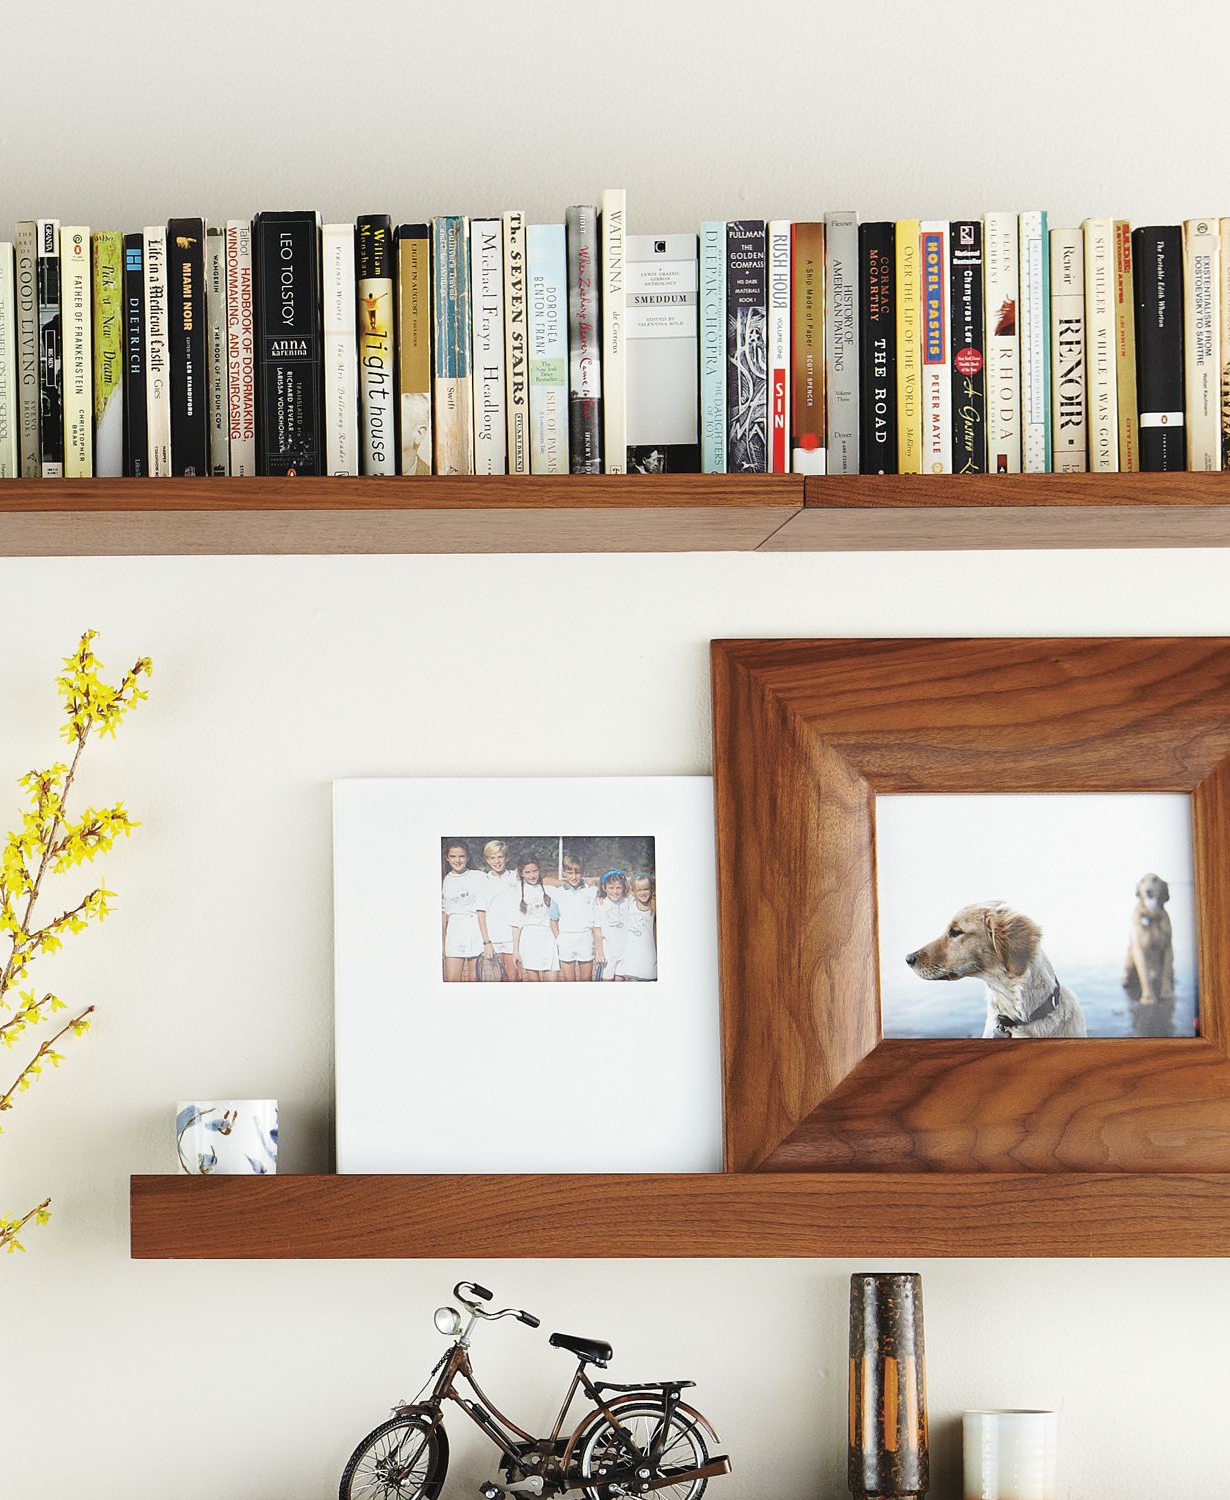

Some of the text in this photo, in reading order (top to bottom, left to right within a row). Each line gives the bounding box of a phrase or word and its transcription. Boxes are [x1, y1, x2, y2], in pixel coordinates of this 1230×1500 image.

[360, 225, 371, 276] Monahan
[373, 229, 385, 275] William
[729, 231, 764, 239] PULLMAN
[730, 252, 764, 260] GOLDEN
[730, 261, 764, 269] COMPASS
[182, 263, 192, 331] MIAMI NOIR
[279, 233, 294, 326] LEO TOLSTOY
[410, 243, 419, 315] LIGHT IN AUGUST
[477, 232, 497, 351] Michael Frayn
[634, 295, 687, 304] SMEDDUM
[705, 231, 719, 376] DEEPAK CHOPRA
[833, 259, 844, 372] AMERICAN PAINTING
[844, 285, 853, 345] HISTORY OF
[870, 250, 880, 321] McCARTHY
[880, 257, 889, 313] CORMAC
[928, 242, 940, 355] HOTEL PASTIS
[20, 257, 35, 385] GOOD LIVING
[74, 276, 83, 395] FATHER OF FRANKENSTEIN
[129, 298, 140, 373] DIETRICH
[446, 387, 455, 410] Swift
[479, 365, 499, 440] Headlong
[874, 339, 887, 443] THE ROAD
[1000, 348, 1013, 441] RHODA
[1058, 319, 1083, 430] RENOIR
[932, 375, 941, 454] PETER MAYLE
